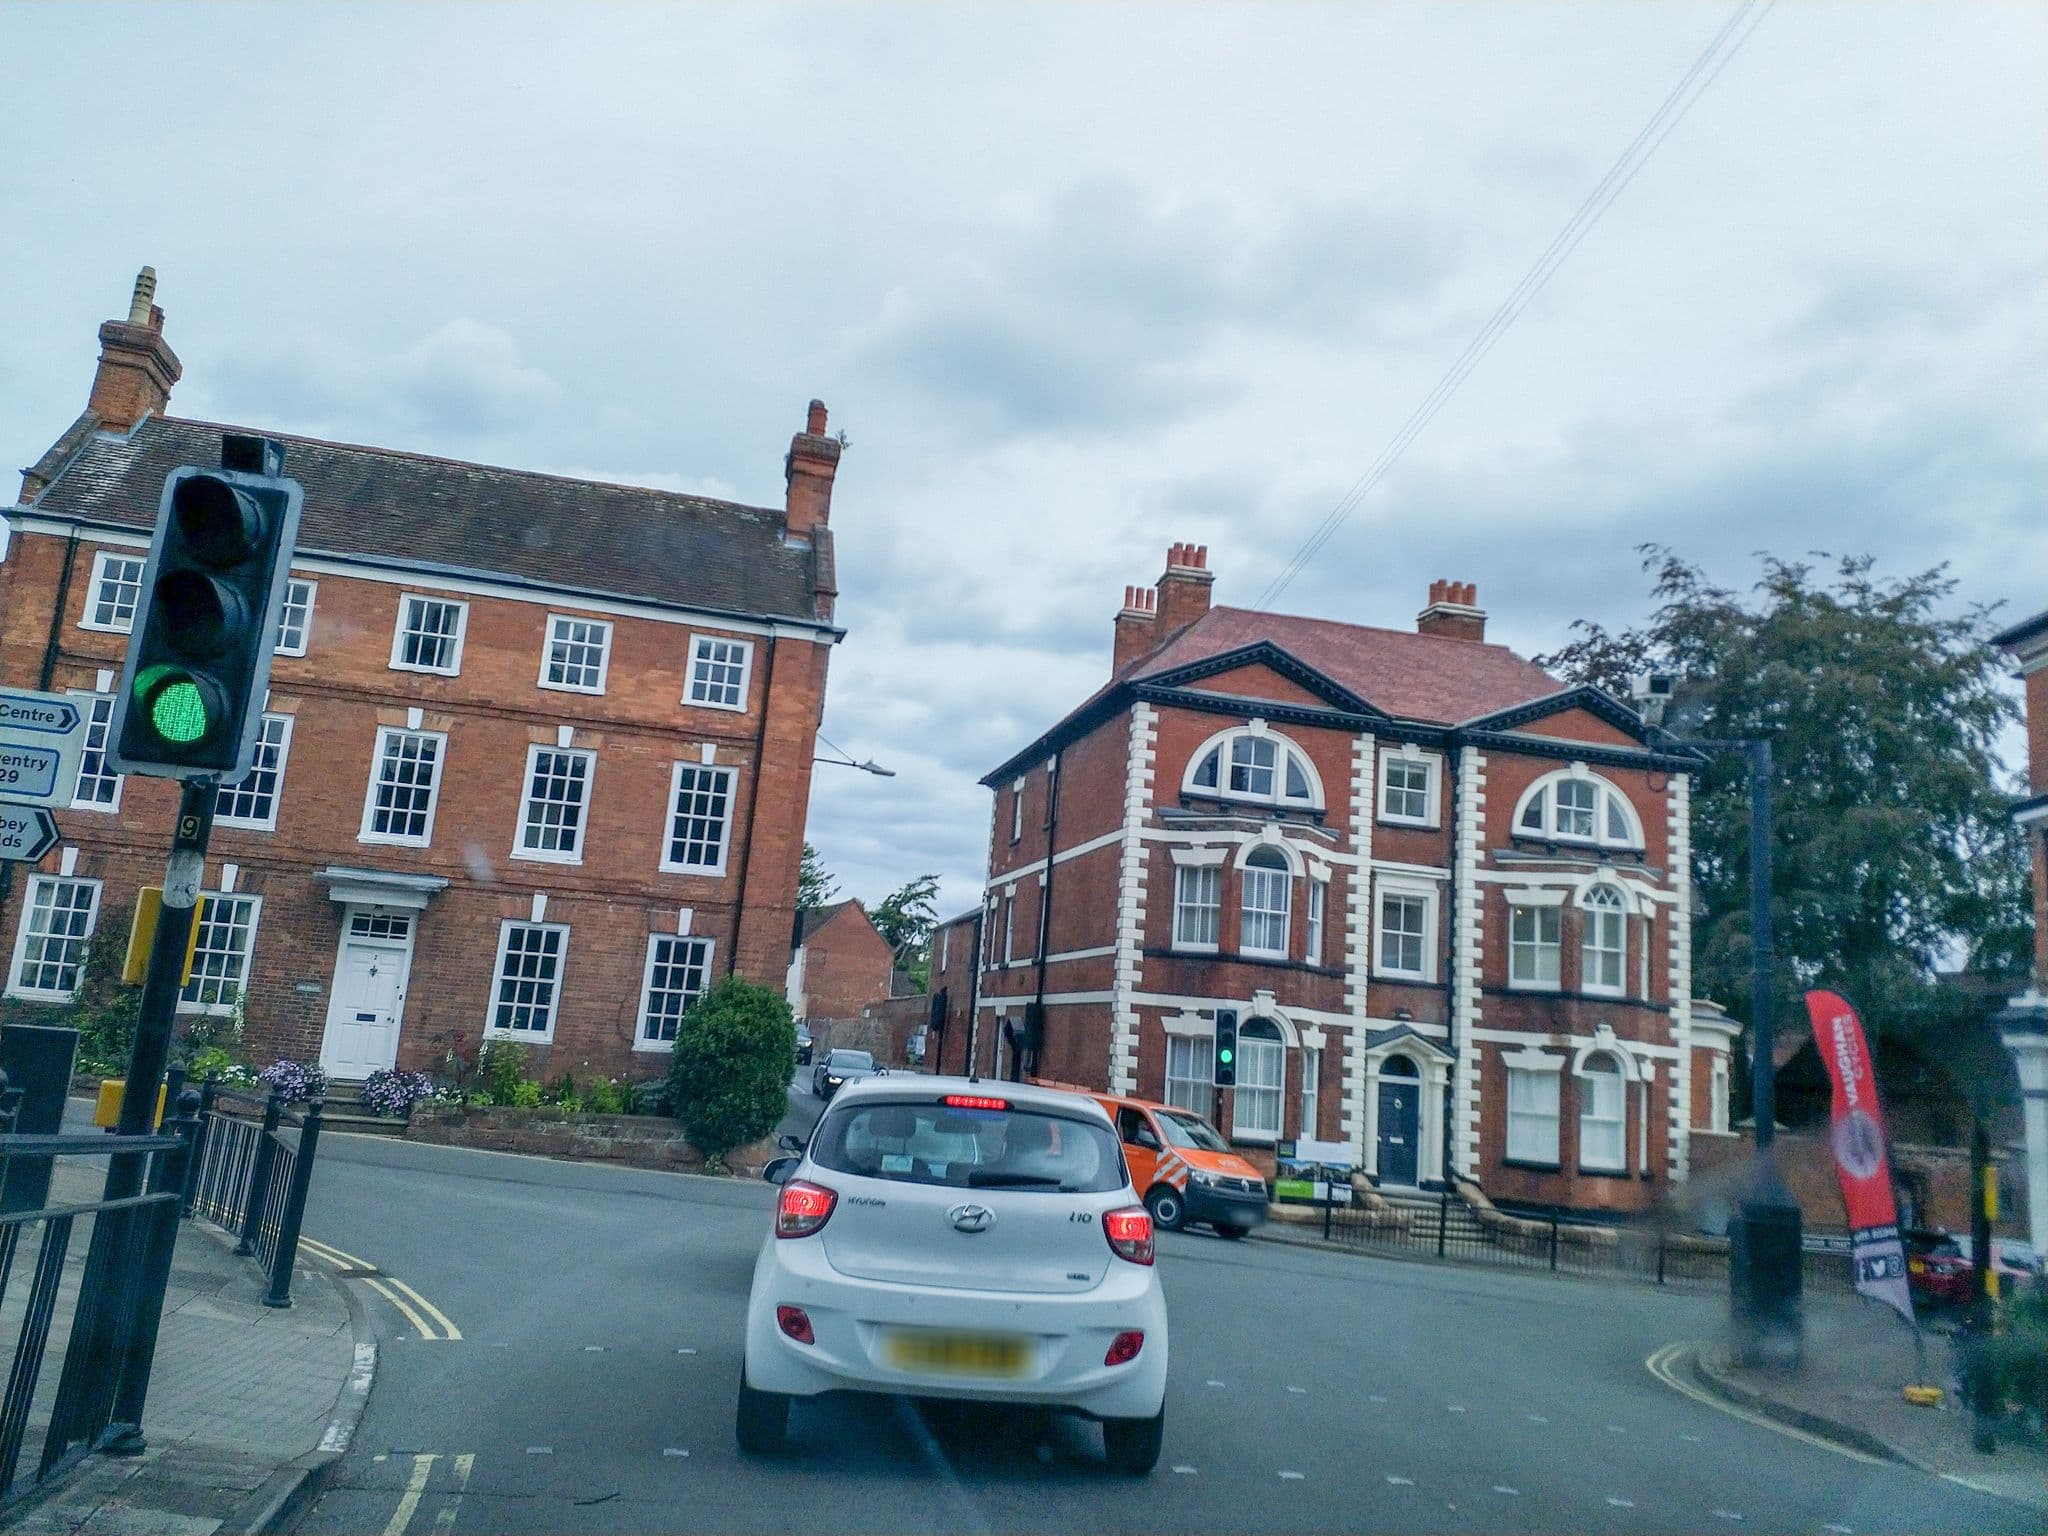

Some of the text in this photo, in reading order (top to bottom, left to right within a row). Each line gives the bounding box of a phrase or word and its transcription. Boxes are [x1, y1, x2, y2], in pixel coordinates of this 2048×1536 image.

[0, 704, 54, 723] Centre
[0, 755, 48, 771] entry
[182, 817, 198, 837] 9
